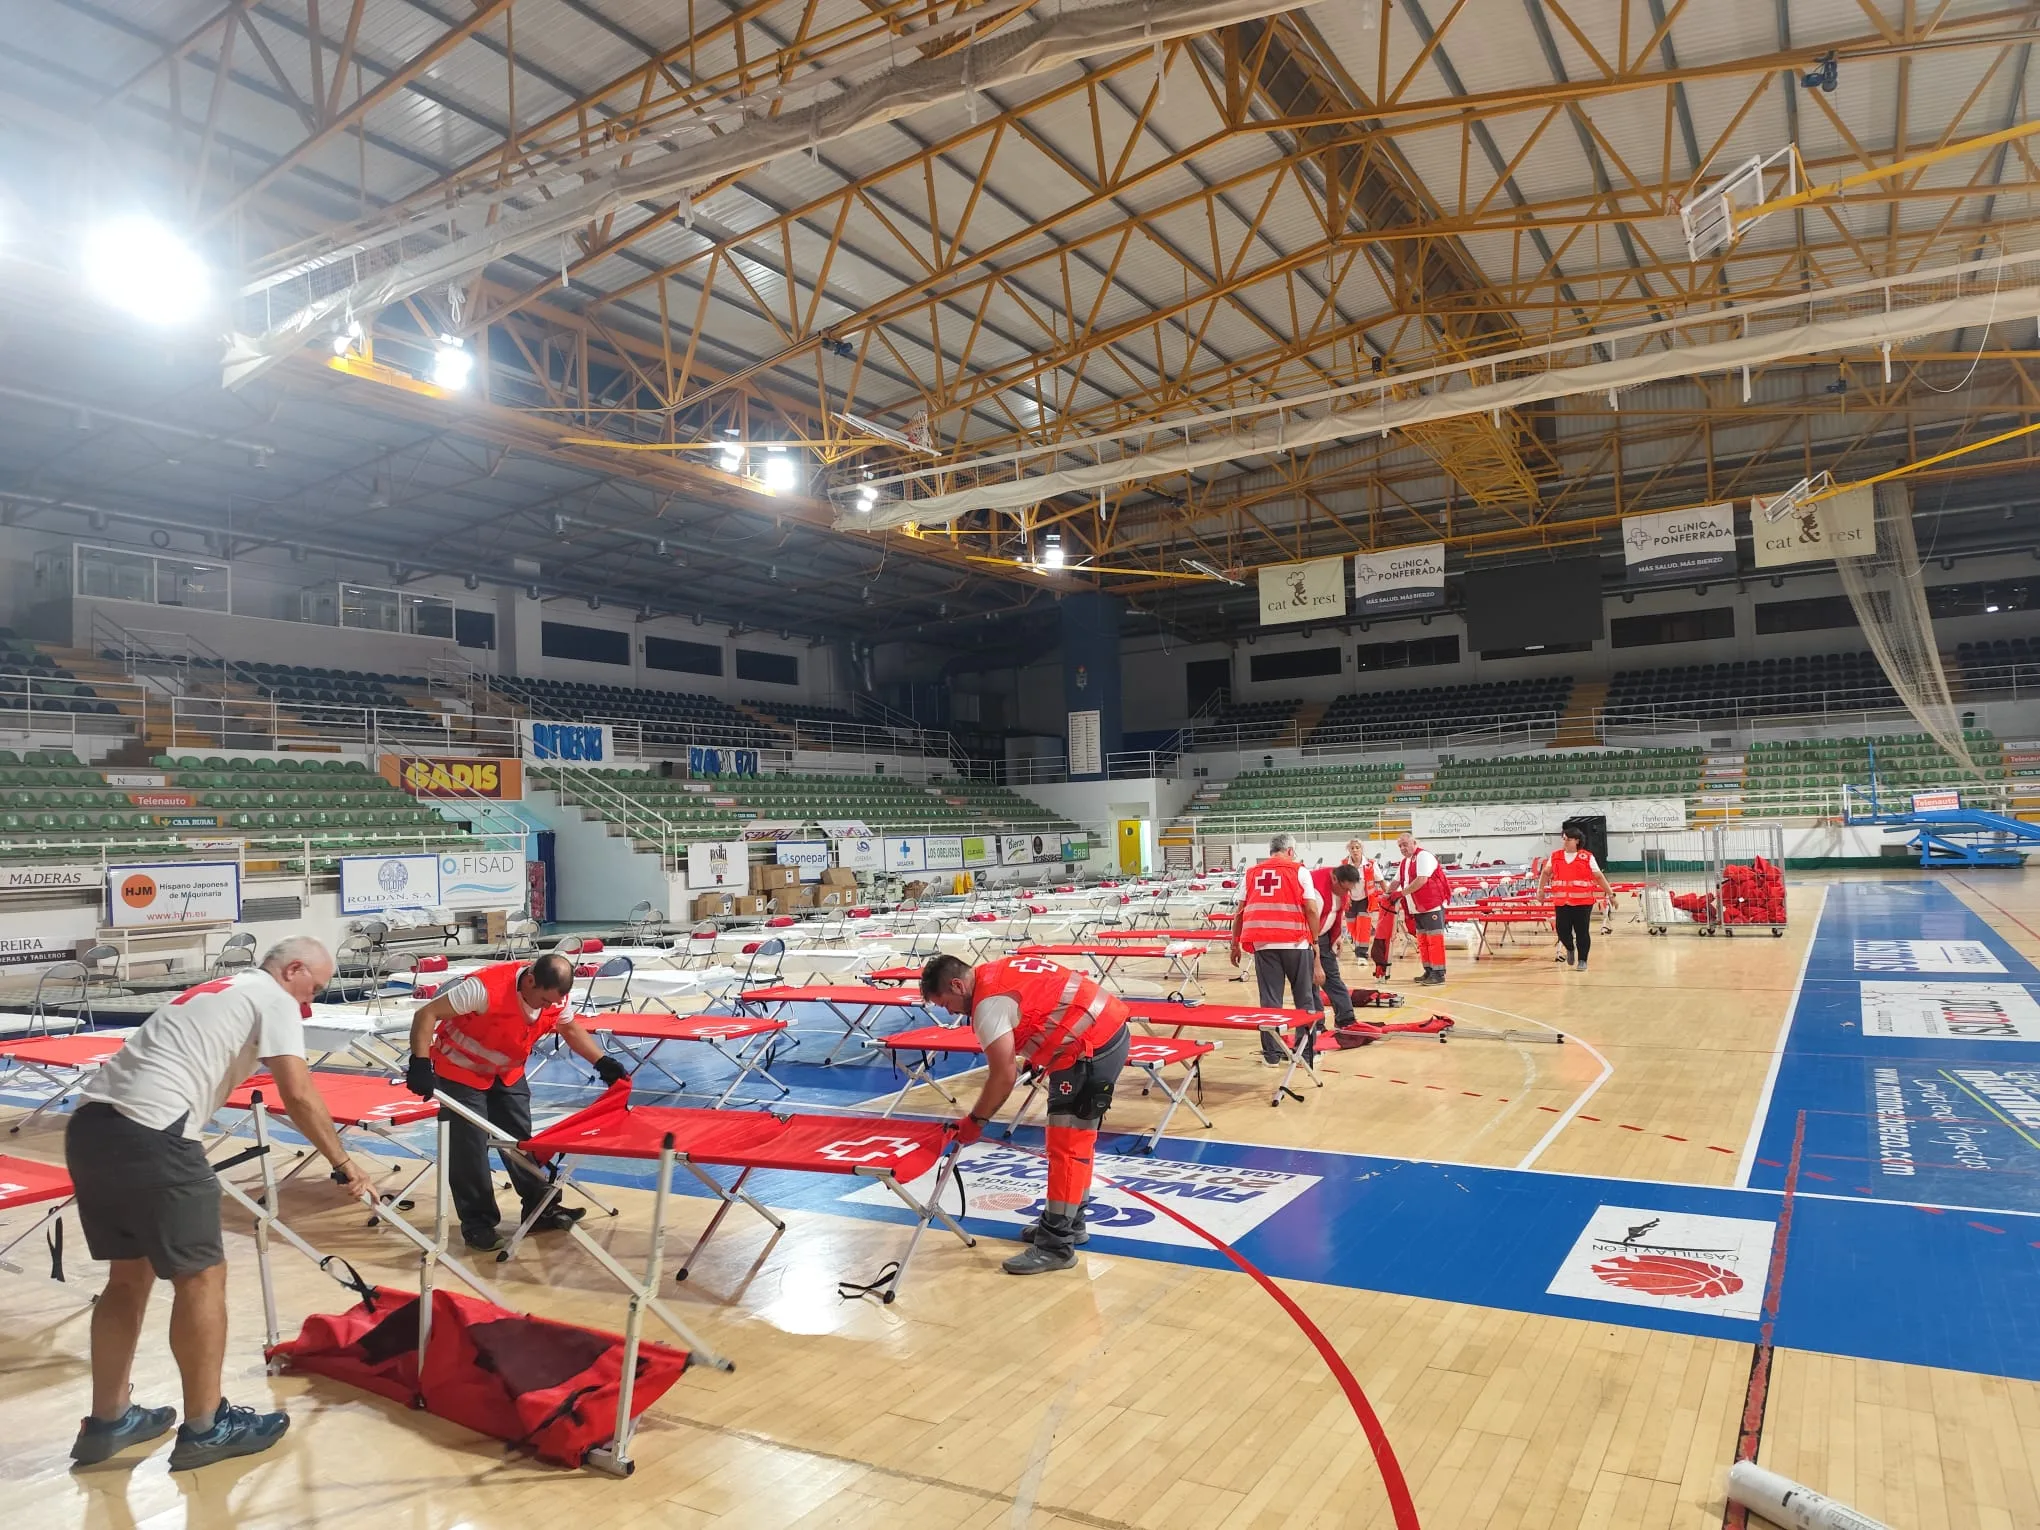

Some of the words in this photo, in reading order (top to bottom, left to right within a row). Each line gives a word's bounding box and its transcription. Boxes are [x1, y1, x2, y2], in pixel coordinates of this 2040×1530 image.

[1653, 528, 1733, 546] PONFERRADA
[1765, 536, 1792, 551] cat
[1827, 526, 1864, 544] rest
[1378, 565, 1443, 581] PONFERRADA
[1267, 599, 1287, 612] cat
[1312, 592, 1337, 606] rest
[405, 762, 500, 792] GADIS
[137, 796, 187, 806] Telenauto
[1915, 798, 1958, 808] Telenauto
[191, 818, 216, 826] RURAL
[789, 853, 827, 868] sonepar
[927, 848, 936, 859] LOS
[463, 856, 515, 875] FISAD
[9, 872, 82, 886] MADERAS
[159, 882, 191, 891] Hispano
[192, 881, 229, 890] Japonesa
[125, 886, 153, 897] HJM
[169, 891, 179, 900] de
[146, 909, 207, 921] www.hjm.eu
[30, 952, 67, 961] TABLEROS
[1928, 1125, 2005, 1170] Proyectos
[1143, 1158, 1230, 1174] CADETE
[1140, 1169, 1280, 1189] 2015
[1239, 1169, 1296, 1181] LIGA
[1105, 1174, 1268, 1205] FINAL
[1655, 1249, 1740, 1262] CASTILLA
